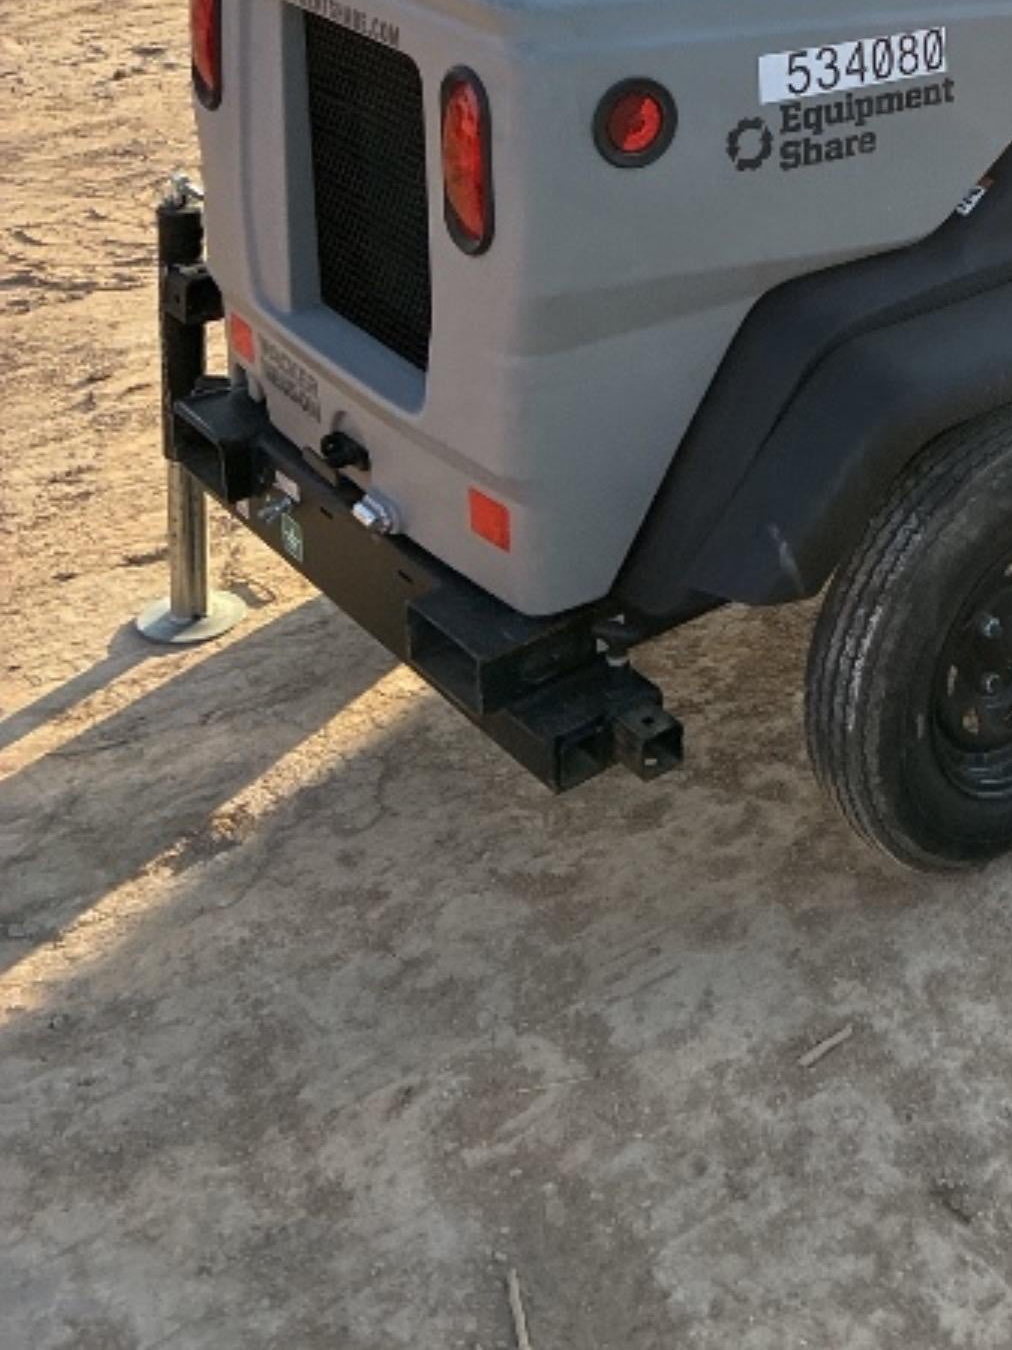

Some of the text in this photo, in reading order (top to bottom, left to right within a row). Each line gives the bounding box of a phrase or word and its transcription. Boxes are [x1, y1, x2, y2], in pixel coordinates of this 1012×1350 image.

[787, 29, 944, 94] 534080
[780, 77, 955, 135] Equipment
[780, 131, 877, 171] Share
